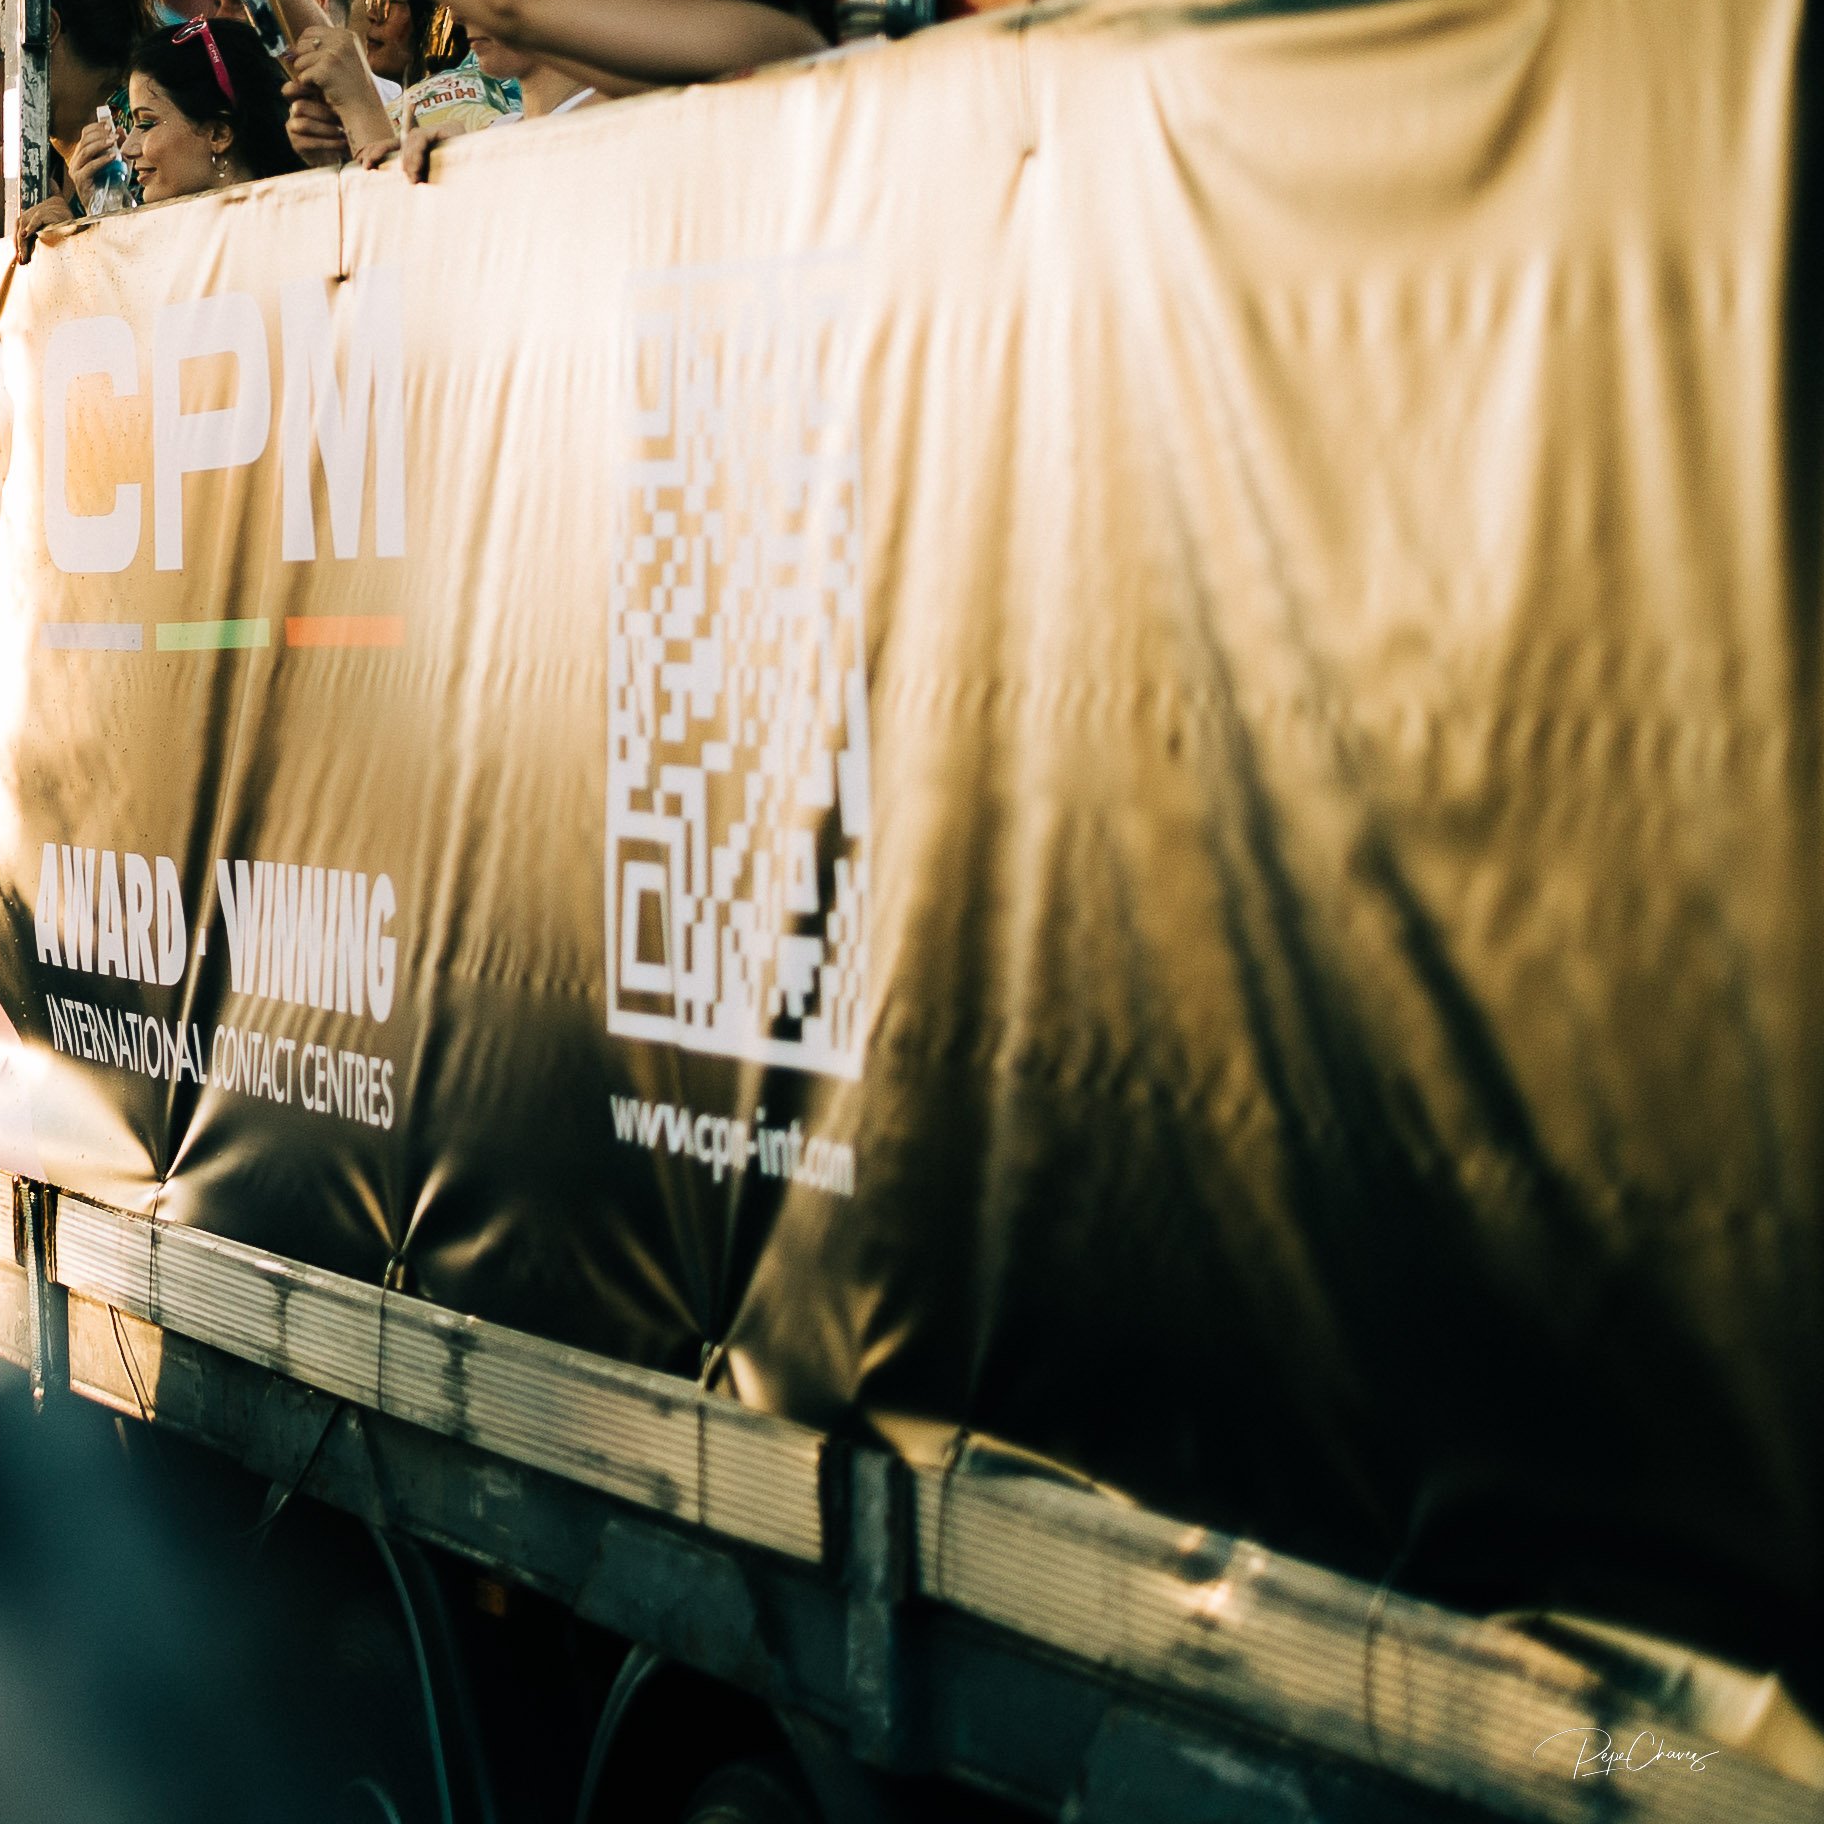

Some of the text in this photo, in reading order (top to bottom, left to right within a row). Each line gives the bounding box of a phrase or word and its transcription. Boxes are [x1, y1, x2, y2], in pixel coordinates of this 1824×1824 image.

[43, 265, 406, 573] CPM
[46, 993, 395, 1130] INTERNATIONAL CONTACT CENTRES
